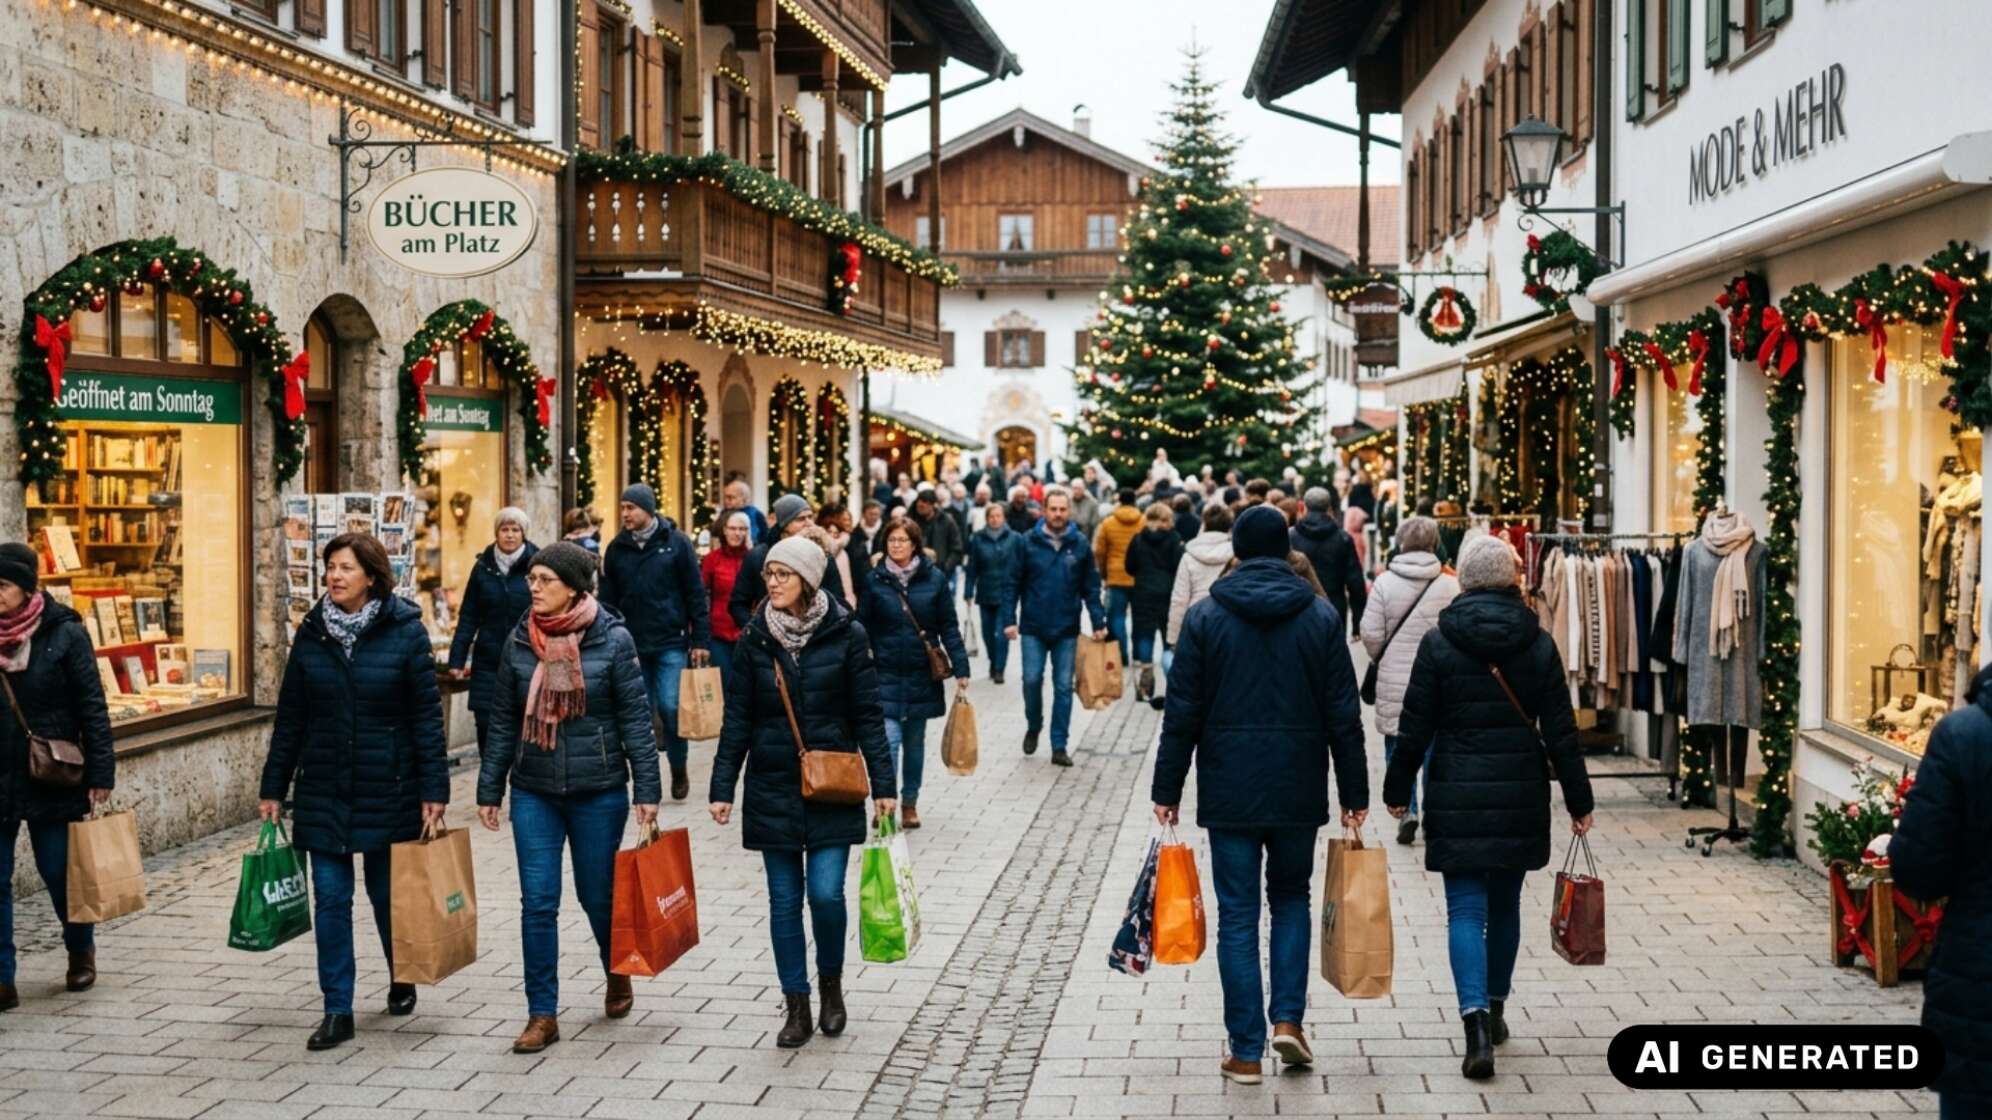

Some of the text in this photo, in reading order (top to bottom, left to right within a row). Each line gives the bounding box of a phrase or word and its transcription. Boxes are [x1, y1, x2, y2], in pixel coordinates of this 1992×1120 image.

[1689, 63, 1846, 206] MODE & MEHR
[384, 194, 518, 227] BÜCHER
[401, 232, 501, 253] am Platz
[129, 391, 152, 411] am
[156, 384, 214, 422] Sonntag
